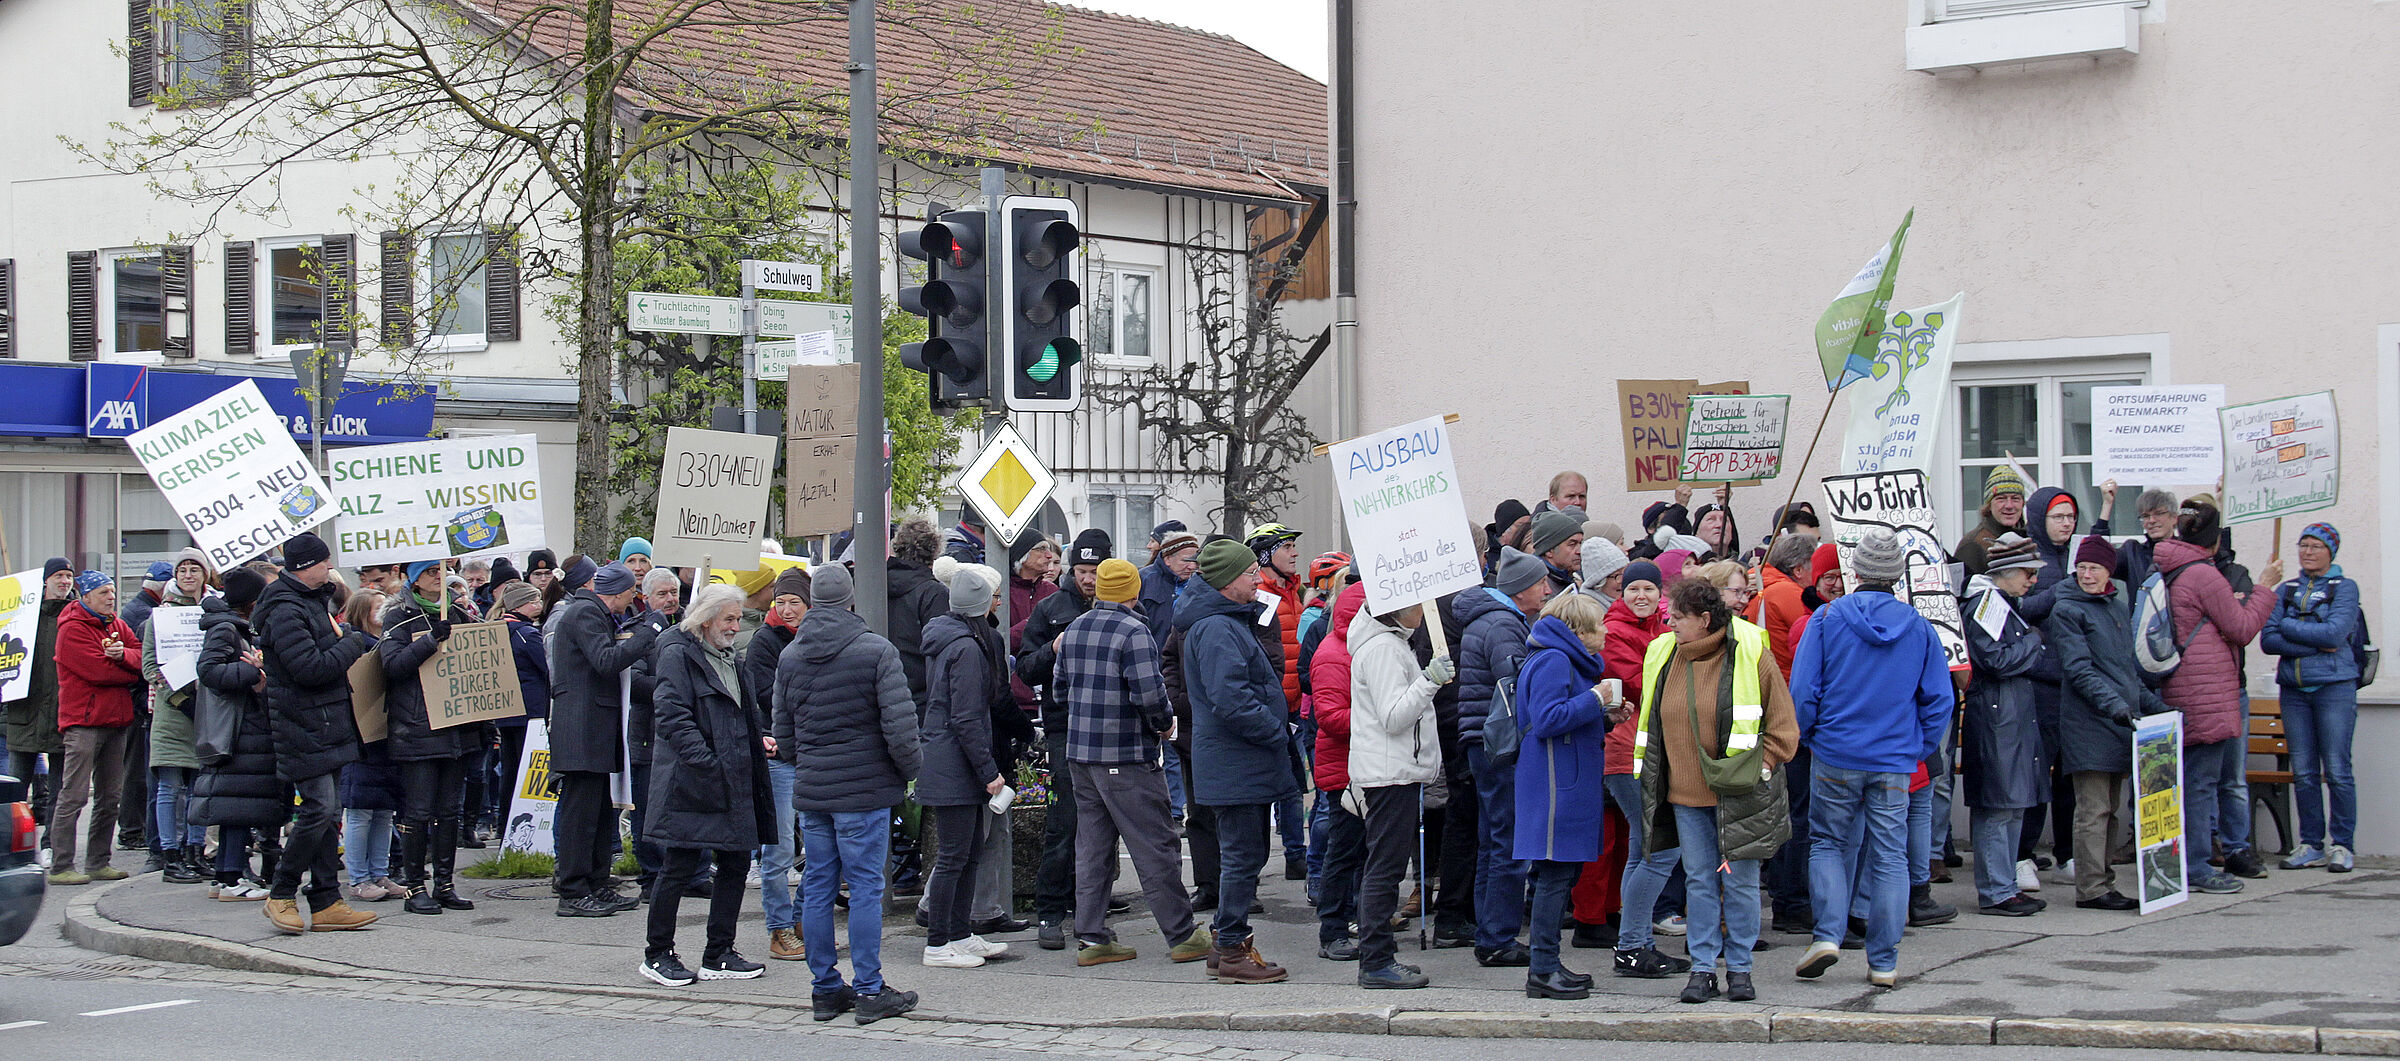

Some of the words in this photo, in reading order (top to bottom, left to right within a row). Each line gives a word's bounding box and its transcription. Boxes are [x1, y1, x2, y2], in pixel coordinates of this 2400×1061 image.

[763, 267, 813, 291] Schulweg
[653, 300, 711, 316] Truchtlaching
[763, 306, 785, 319] Obing
[653, 316, 675, 326] Kloster
[678, 317, 710, 329] Baumburg
[763, 322, 788, 332] Seeon
[772, 347, 796, 358] Traun
[1700, 400, 1745, 418] Getreide
[1753, 401, 1769, 418] für
[2108, 393, 2207, 404] ORTSUMFAHRUNG
[90, 400, 140, 430] AXA
[794, 408, 835, 435] NATUR
[2108, 406, 2188, 417] ALTENMARKT?
[136, 396, 260, 464] KLIMAZIEL
[293, 415, 308, 434] &
[1691, 419, 1747, 433] Menschen
[1754, 420, 1781, 434] statt
[2115, 425, 2140, 434] NEIN
[2143, 424, 2185, 434] DANKE!
[813, 444, 839, 457] ERHALT
[1349, 427, 1440, 480] AUSBAU
[1688, 434, 1734, 453] Asphalt
[157, 427, 266, 490] GERISSEN
[334, 452, 443, 482] SCHIENE
[466, 447, 525, 471] UND
[1682, 452, 1724, 475] STOPP
[1384, 473, 1400, 484] des
[184, 493, 244, 533] B304
[256, 460, 308, 497] NEU
[425, 480, 537, 509] WISSING
[1353, 471, 1449, 518] NAHVERKEHRS
[678, 507, 708, 537] Nein
[711, 513, 756, 539] Danke!
[1398, 527, 1419, 542] statt
[340, 524, 442, 553] ERHALZ
[1374, 547, 1429, 577] Ausbau
[1436, 538, 1457, 557] des
[1378, 559, 1478, 601] Straßennetzes
[435, 647, 506, 678] GELOGEN!
[444, 689, 514, 718] BETROGEN!
